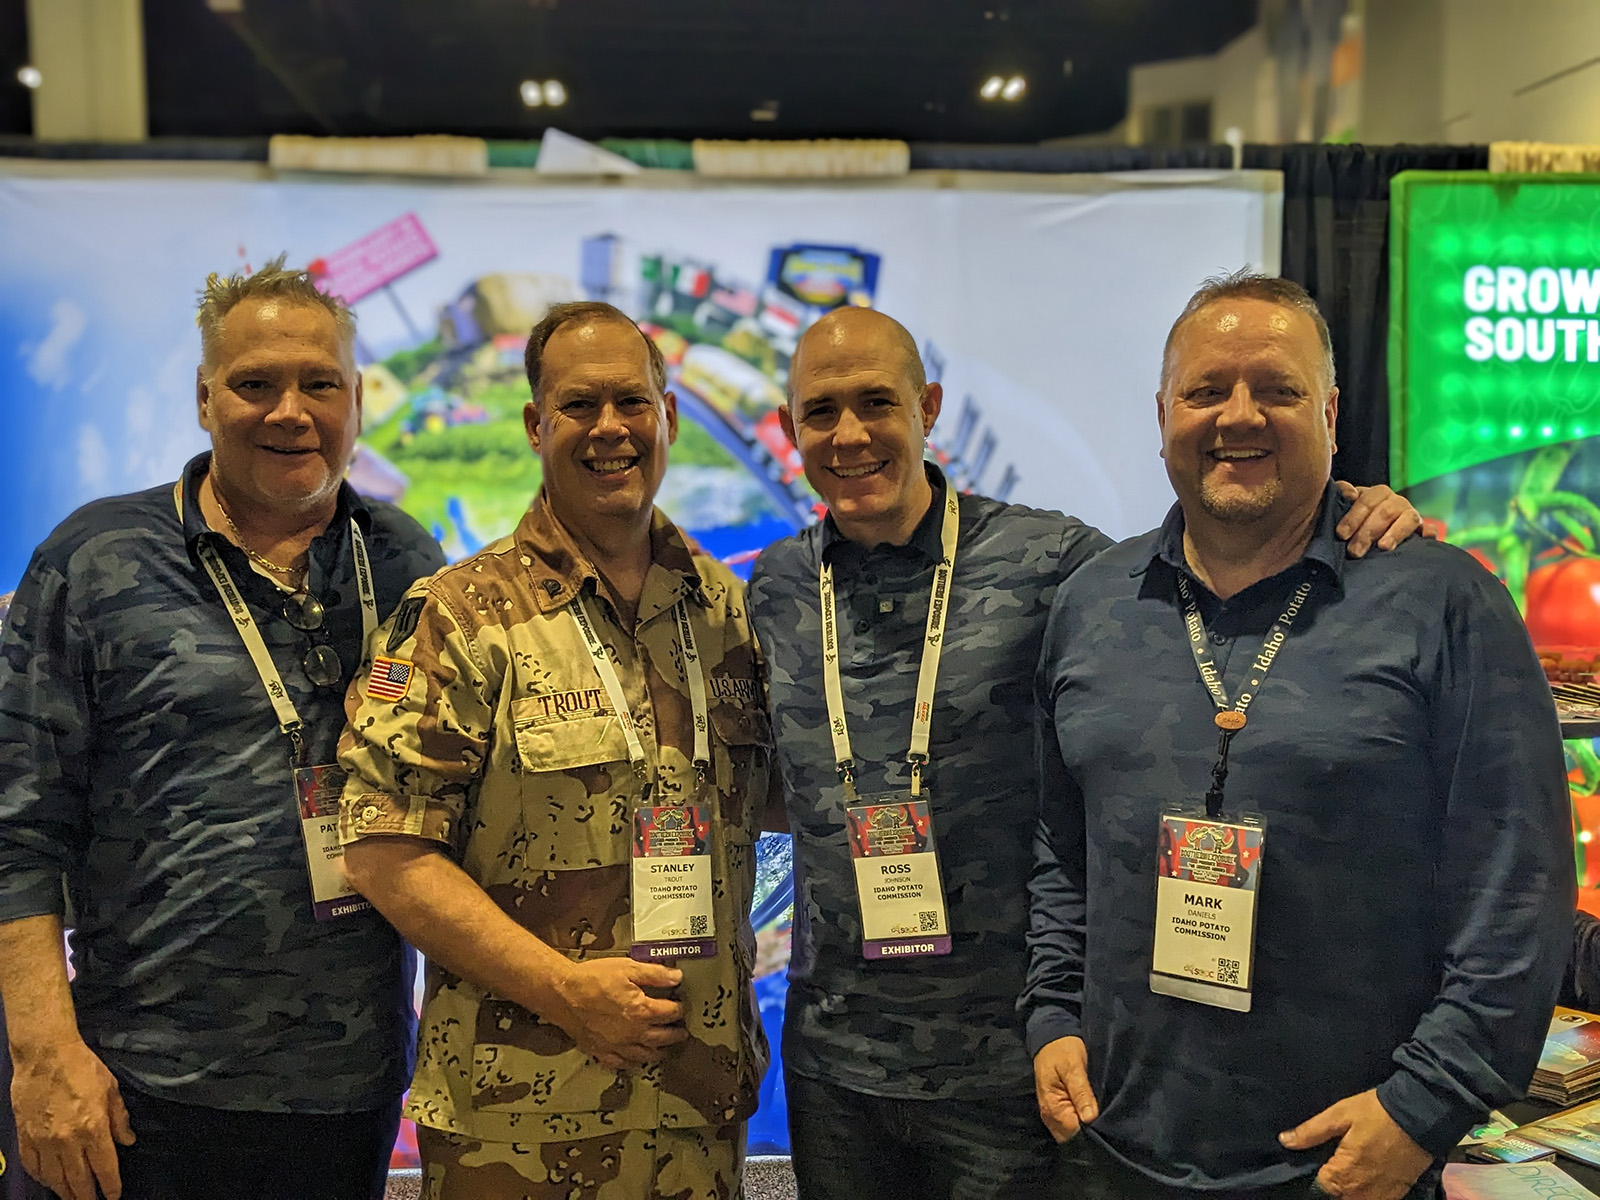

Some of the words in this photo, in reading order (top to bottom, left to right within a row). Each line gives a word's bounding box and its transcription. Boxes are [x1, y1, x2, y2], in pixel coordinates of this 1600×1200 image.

[1463, 264, 1600, 314] GROW
[1185, 601, 1201, 642] Potato
[1252, 632, 1285, 673] Idaho
[1278, 582, 1312, 626] Potato
[1199, 660, 1222, 696] Idaho
[538, 689, 601, 717] TROUT
[650, 863, 695, 874] STANLEY
[881, 863, 912, 875] ROSS
[672, 884, 698, 892] POTATO
[873, 885, 895, 894] IDAHO
[896, 883, 924, 892] POTATO
[652, 892, 695, 900] COMMISSION
[877, 891, 922, 901] COMMISSION
[1184, 893, 1223, 910] MARK
[1187, 909, 1217, 920] DANIELS
[1171, 916, 1197, 928] IDAHO
[1199, 921, 1231, 933] POTATO
[1174, 926, 1227, 942] COMMISSION
[650, 945, 701, 957] EXHIBITOR
[881, 943, 935, 955] EXHIBITOR
